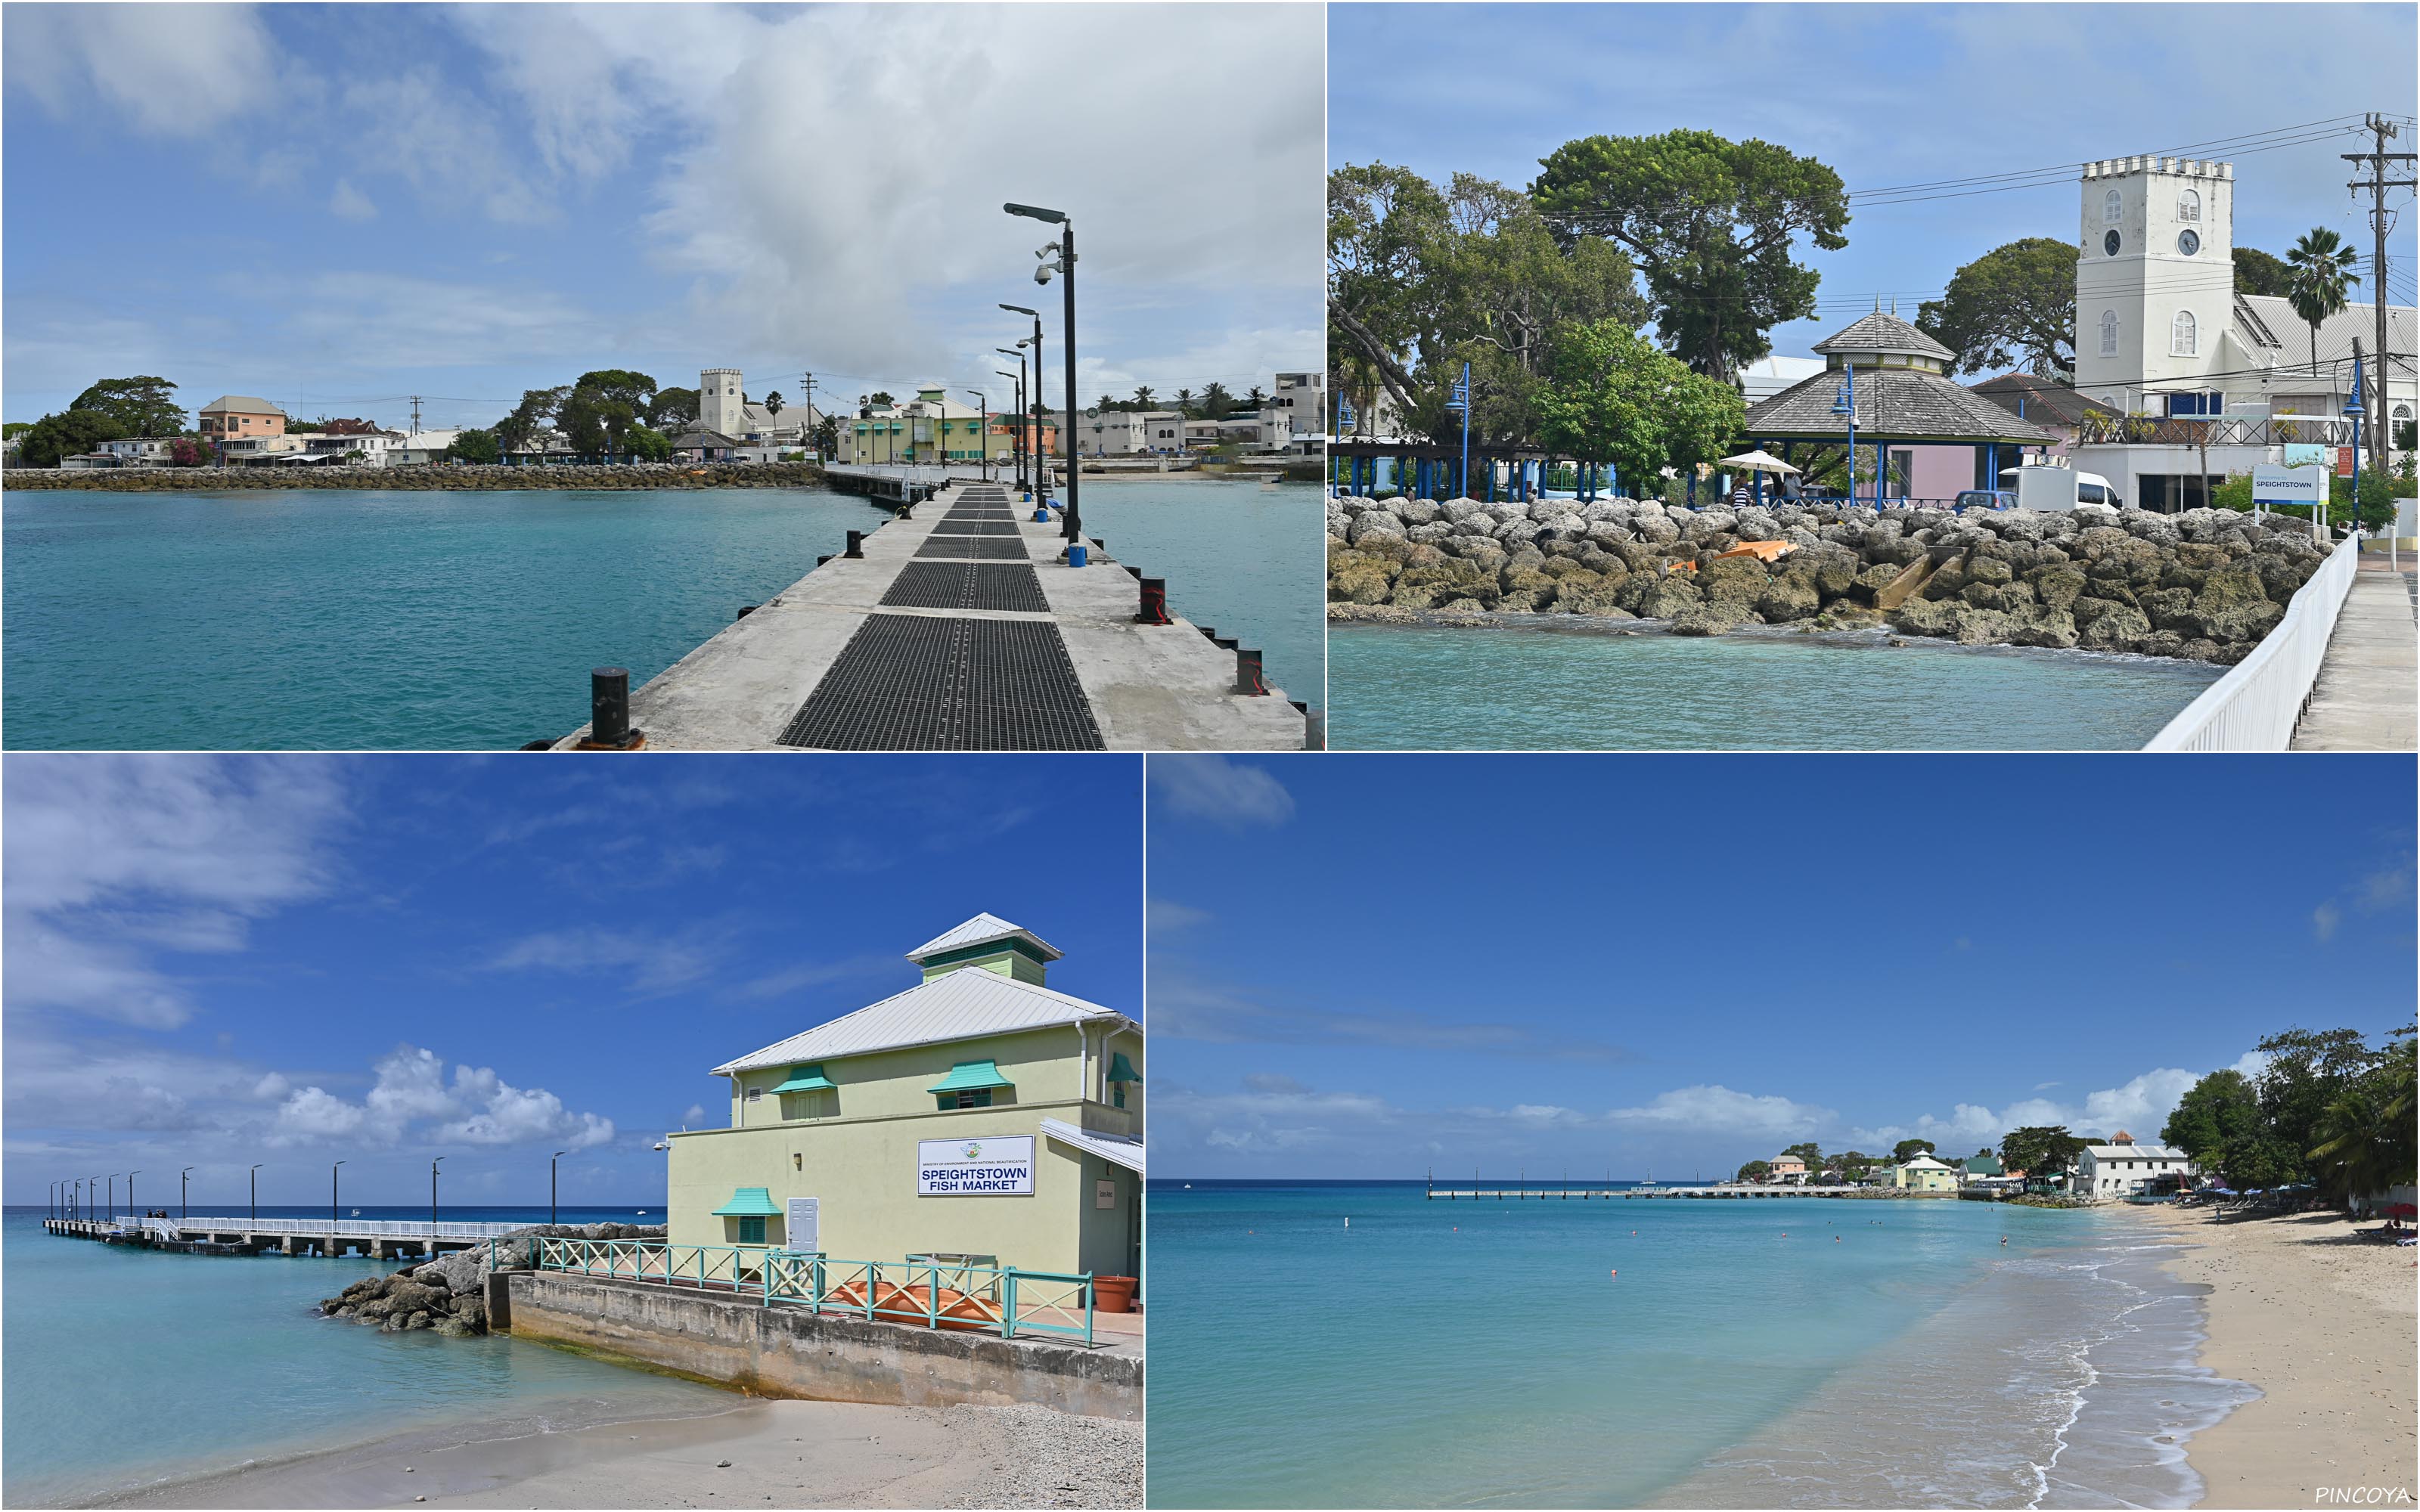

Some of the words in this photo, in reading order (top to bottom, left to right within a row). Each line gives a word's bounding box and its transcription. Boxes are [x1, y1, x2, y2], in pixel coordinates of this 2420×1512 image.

[922, 1167, 1027, 1180] SPEIGHTSTOWN
[929, 1181, 958, 1191] FISH
[963, 1180, 1018, 1191] MARKET
